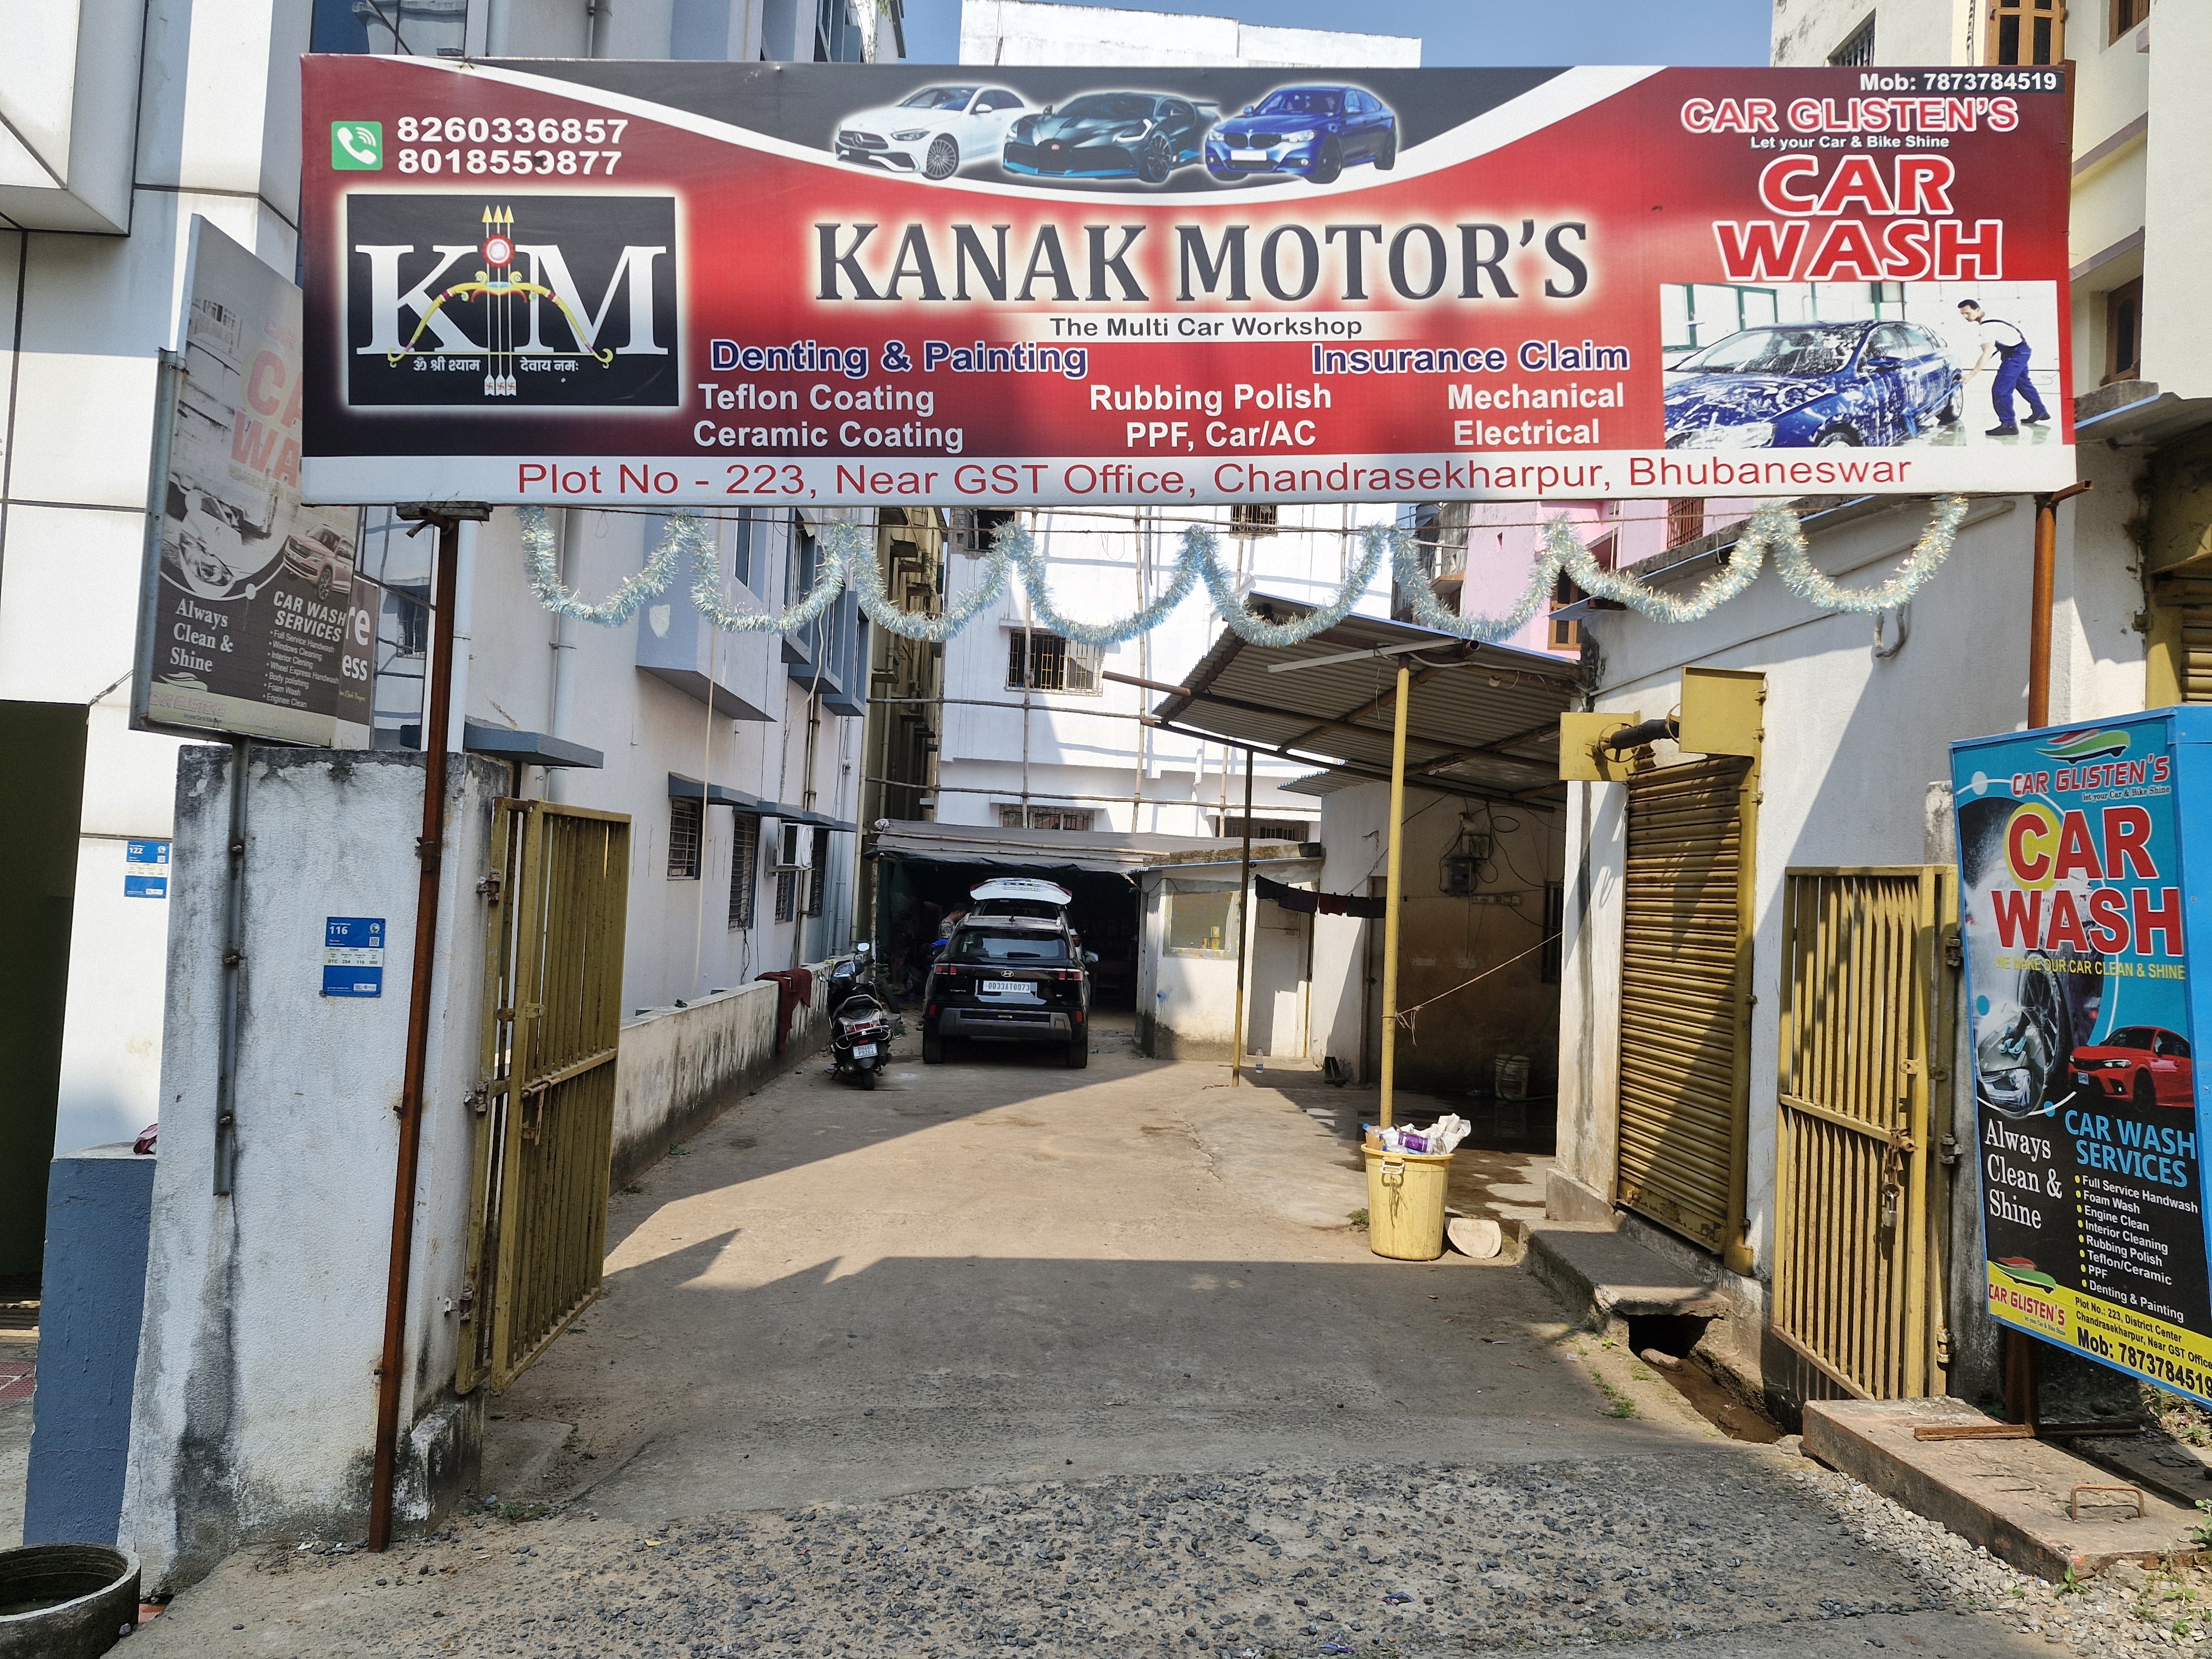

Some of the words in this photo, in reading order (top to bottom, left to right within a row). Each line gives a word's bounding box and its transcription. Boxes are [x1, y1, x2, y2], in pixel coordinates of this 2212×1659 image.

[1860, 74, 1916, 91] Mob:
[1924, 73, 2056, 90] 7873784519
[397, 117, 628, 144] 8260336857
[1681, 98, 1778, 133] CAR
[1788, 97, 2018, 133] GLISTEN'S
[1751, 137, 1775, 149] Let
[1780, 138, 1814, 151] your
[1819, 137, 1846, 148] Car
[1851, 136, 1861, 148] &
[1867, 136, 1900, 148] Bike
[1906, 136, 1949, 148] Shine
[398, 149, 622, 175] 8018553877
[1759, 155, 1954, 216] CAR
[815, 223, 1149, 301] KANAK
[1176, 219, 1587, 301] MOTOR'S
[1713, 219, 2002, 282] WASH
[1051, 318, 1097, 336] The
[1107, 317, 1168, 337] Multi
[1177, 318, 1224, 336] Car
[1232, 317, 1362, 340] Workshop
[710, 340, 869, 379] Denting
[883, 341, 911, 372] &
[924, 341, 1088, 378] Painting
[1311, 343, 1507, 374] Insurance
[1519, 340, 1630, 372] Claim
[698, 384, 798, 410] Teflon
[810, 384, 934, 416] Coating
[1090, 384, 1222, 418] Rubbing
[1234, 383, 1331, 410] Polish
[1448, 382, 1624, 410] Mechanical
[693, 420, 828, 447] Ceramic
[839, 421, 963, 453] Coating
[1126, 422, 1194, 452] PPF,
[1206, 420, 1316, 447] Car/AC
[1454, 419, 1599, 446] Electrical
[519, 463, 601, 494] Plot
[620, 465, 678, 494] No
[726, 465, 817, 499] 223,
[837, 465, 938, 494] Near
[954, 464, 1048, 494] GST
[1064, 463, 1195, 498] Office,
[1214, 461, 1610, 495] Chandrasekharpur,
[1629, 456, 1912, 486] Bhubaneswar
[175, 598, 228, 630] Always
[273, 591, 303, 613] CAR
[307, 601, 347, 627] WASH
[173, 623, 216, 649] Clean
[221, 635, 233, 654] &
[274, 629, 285, 639] Full
[286, 633, 306, 646] Service
[307, 639, 334, 653] Handwash
[275, 610, 342, 642] SERVICES
[170, 647, 212, 672] Shine
[271, 651, 291, 663] Interior
[273, 640, 298, 654] Windows
[299, 648, 322, 662] Cleaning
[269, 672, 284, 683] Body
[284, 676, 309, 690] polishing
[270, 661, 288, 673] Wheel
[289, 666, 311, 679] Express
[312, 671, 339, 685] Handwash
[268, 683, 284, 693] Foam
[285, 686, 301, 697] Wash
[291, 698, 307, 708] Clean
[2012, 771, 2049, 796] CAR
[2055, 753, 2169, 792] GLISTEN'S
[2083, 792, 2092, 801] let
[2093, 792, 2109, 802] your
[2110, 789, 2122, 799] Car
[2124, 789, 2130, 797] &
[2131, 786, 2147, 796] Bike
[2150, 784, 2170, 795] Shine
[2008, 805, 2159, 882] CAR
[330, 926, 348, 935] 116
[1991, 886, 2184, 957] WASH
[1996, 956, 2010, 970] WE
[2013, 957, 2040, 972] MAKE
[2043, 958, 2067, 973] OUR
[2069, 960, 2092, 975] CAR
[2095, 961, 2133, 977] CLEAN
[2137, 965, 2146, 978] &
[2148, 964, 2186, 980] SHINE
[1984, 1118, 2051, 1162] Always
[2065, 1110, 2109, 1141] CAR
[2116, 1118, 2195, 1160] WASH
[1987, 1154, 2041, 1193] Clean
[2046, 1167, 2062, 1199] &
[2076, 1140, 2188, 1187] SERVICES
[1989, 1188, 2042, 1229] Shine
[2082, 1175, 2100, 1188] Full
[2103, 1179, 2140, 1199] Service
[2142, 1190, 2199, 1214] Handwash
[2084, 1191, 2110, 1207] Foam
[2112, 1198, 2140, 1214] Wash
[2085, 1204, 2118, 1225] Engine
[2120, 1214, 2150, 1232] Clean
[2085, 1219, 2120, 1239] Interior
[2122, 1228, 2168, 1256] Cleaning
[2086, 1234, 2127, 1259] Rubbing
[2130, 1249, 2163, 1267] Polish
[2088, 1249, 2172, 1286] Teflon/Ceramic
[2088, 1264, 2108, 1280] PPF
[1989, 1283, 2007, 1304] CAR
[2011, 1291, 2065, 1326] GLISTEN'S
[2089, 1279, 2127, 1305] Denting
[2130, 1293, 2138, 1305] &
[2140, 1296, 2184, 1323] Painting
[2075, 1297, 2089, 1311] Plot
[2107, 1308, 2123, 1323] 223,
[2125, 1314, 2153, 1333] District
[2155, 1325, 2182, 1343] Center
[2076, 1311, 2146, 1346] Chandrasekharpur,
[2148, 1335, 2166, 1352] Near
[2168, 1344, 2185, 1359] GST
[2188, 1351, 2212, 1370] Office
[2077, 1327, 2114, 1359] Mob:
[2119, 1342, 2212, 1399] 7873784519
